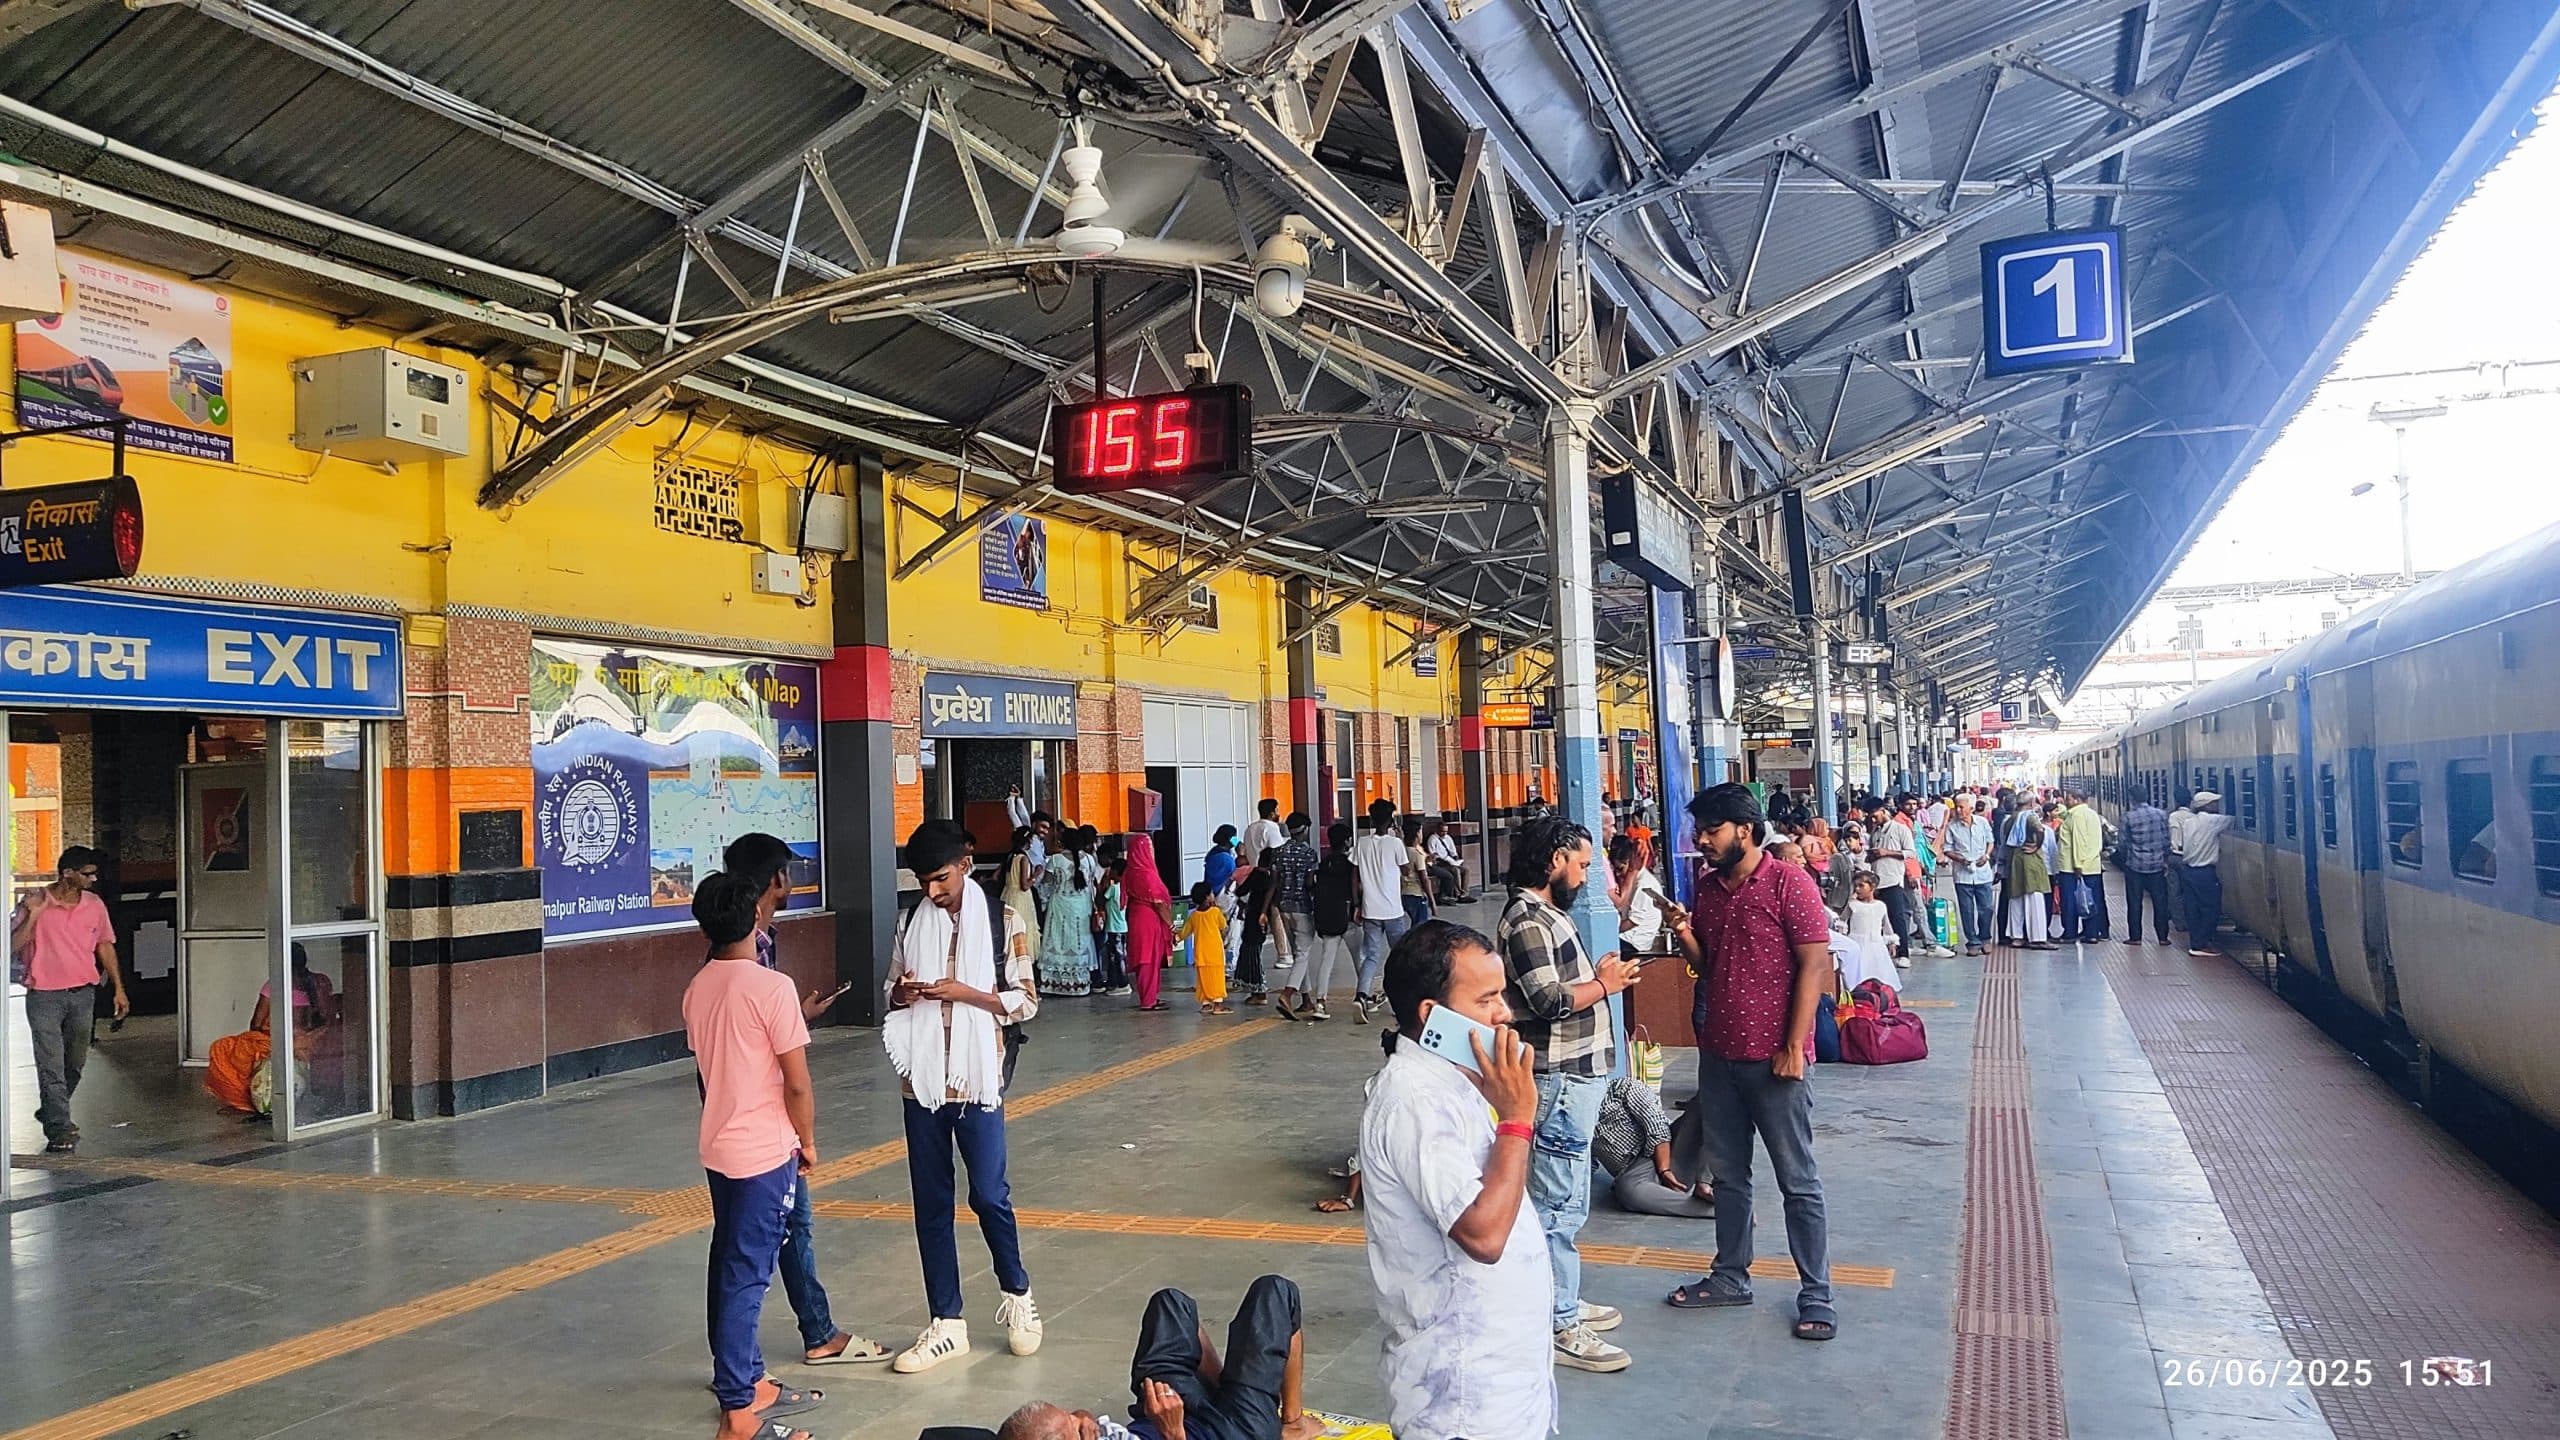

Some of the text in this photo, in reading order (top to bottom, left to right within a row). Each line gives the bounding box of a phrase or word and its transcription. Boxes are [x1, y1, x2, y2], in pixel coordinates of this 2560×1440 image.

[2033, 257, 2077, 338] 1
[26, 499, 99, 530] निकास
[655, 484, 740, 520] AMALPUR
[24, 536, 67, 563] Exit
[0, 628, 382, 692] कास EXIT
[763, 677, 800, 709] Map
[928, 685, 1072, 727] प्रवेश ENTRANCE
[573, 754, 613, 775] INDIAN
[612, 769, 638, 846] RAILWAYS
[543, 901, 577, 921] malpur
[578, 896, 616, 915] Railway
[617, 892, 650, 910] Station
